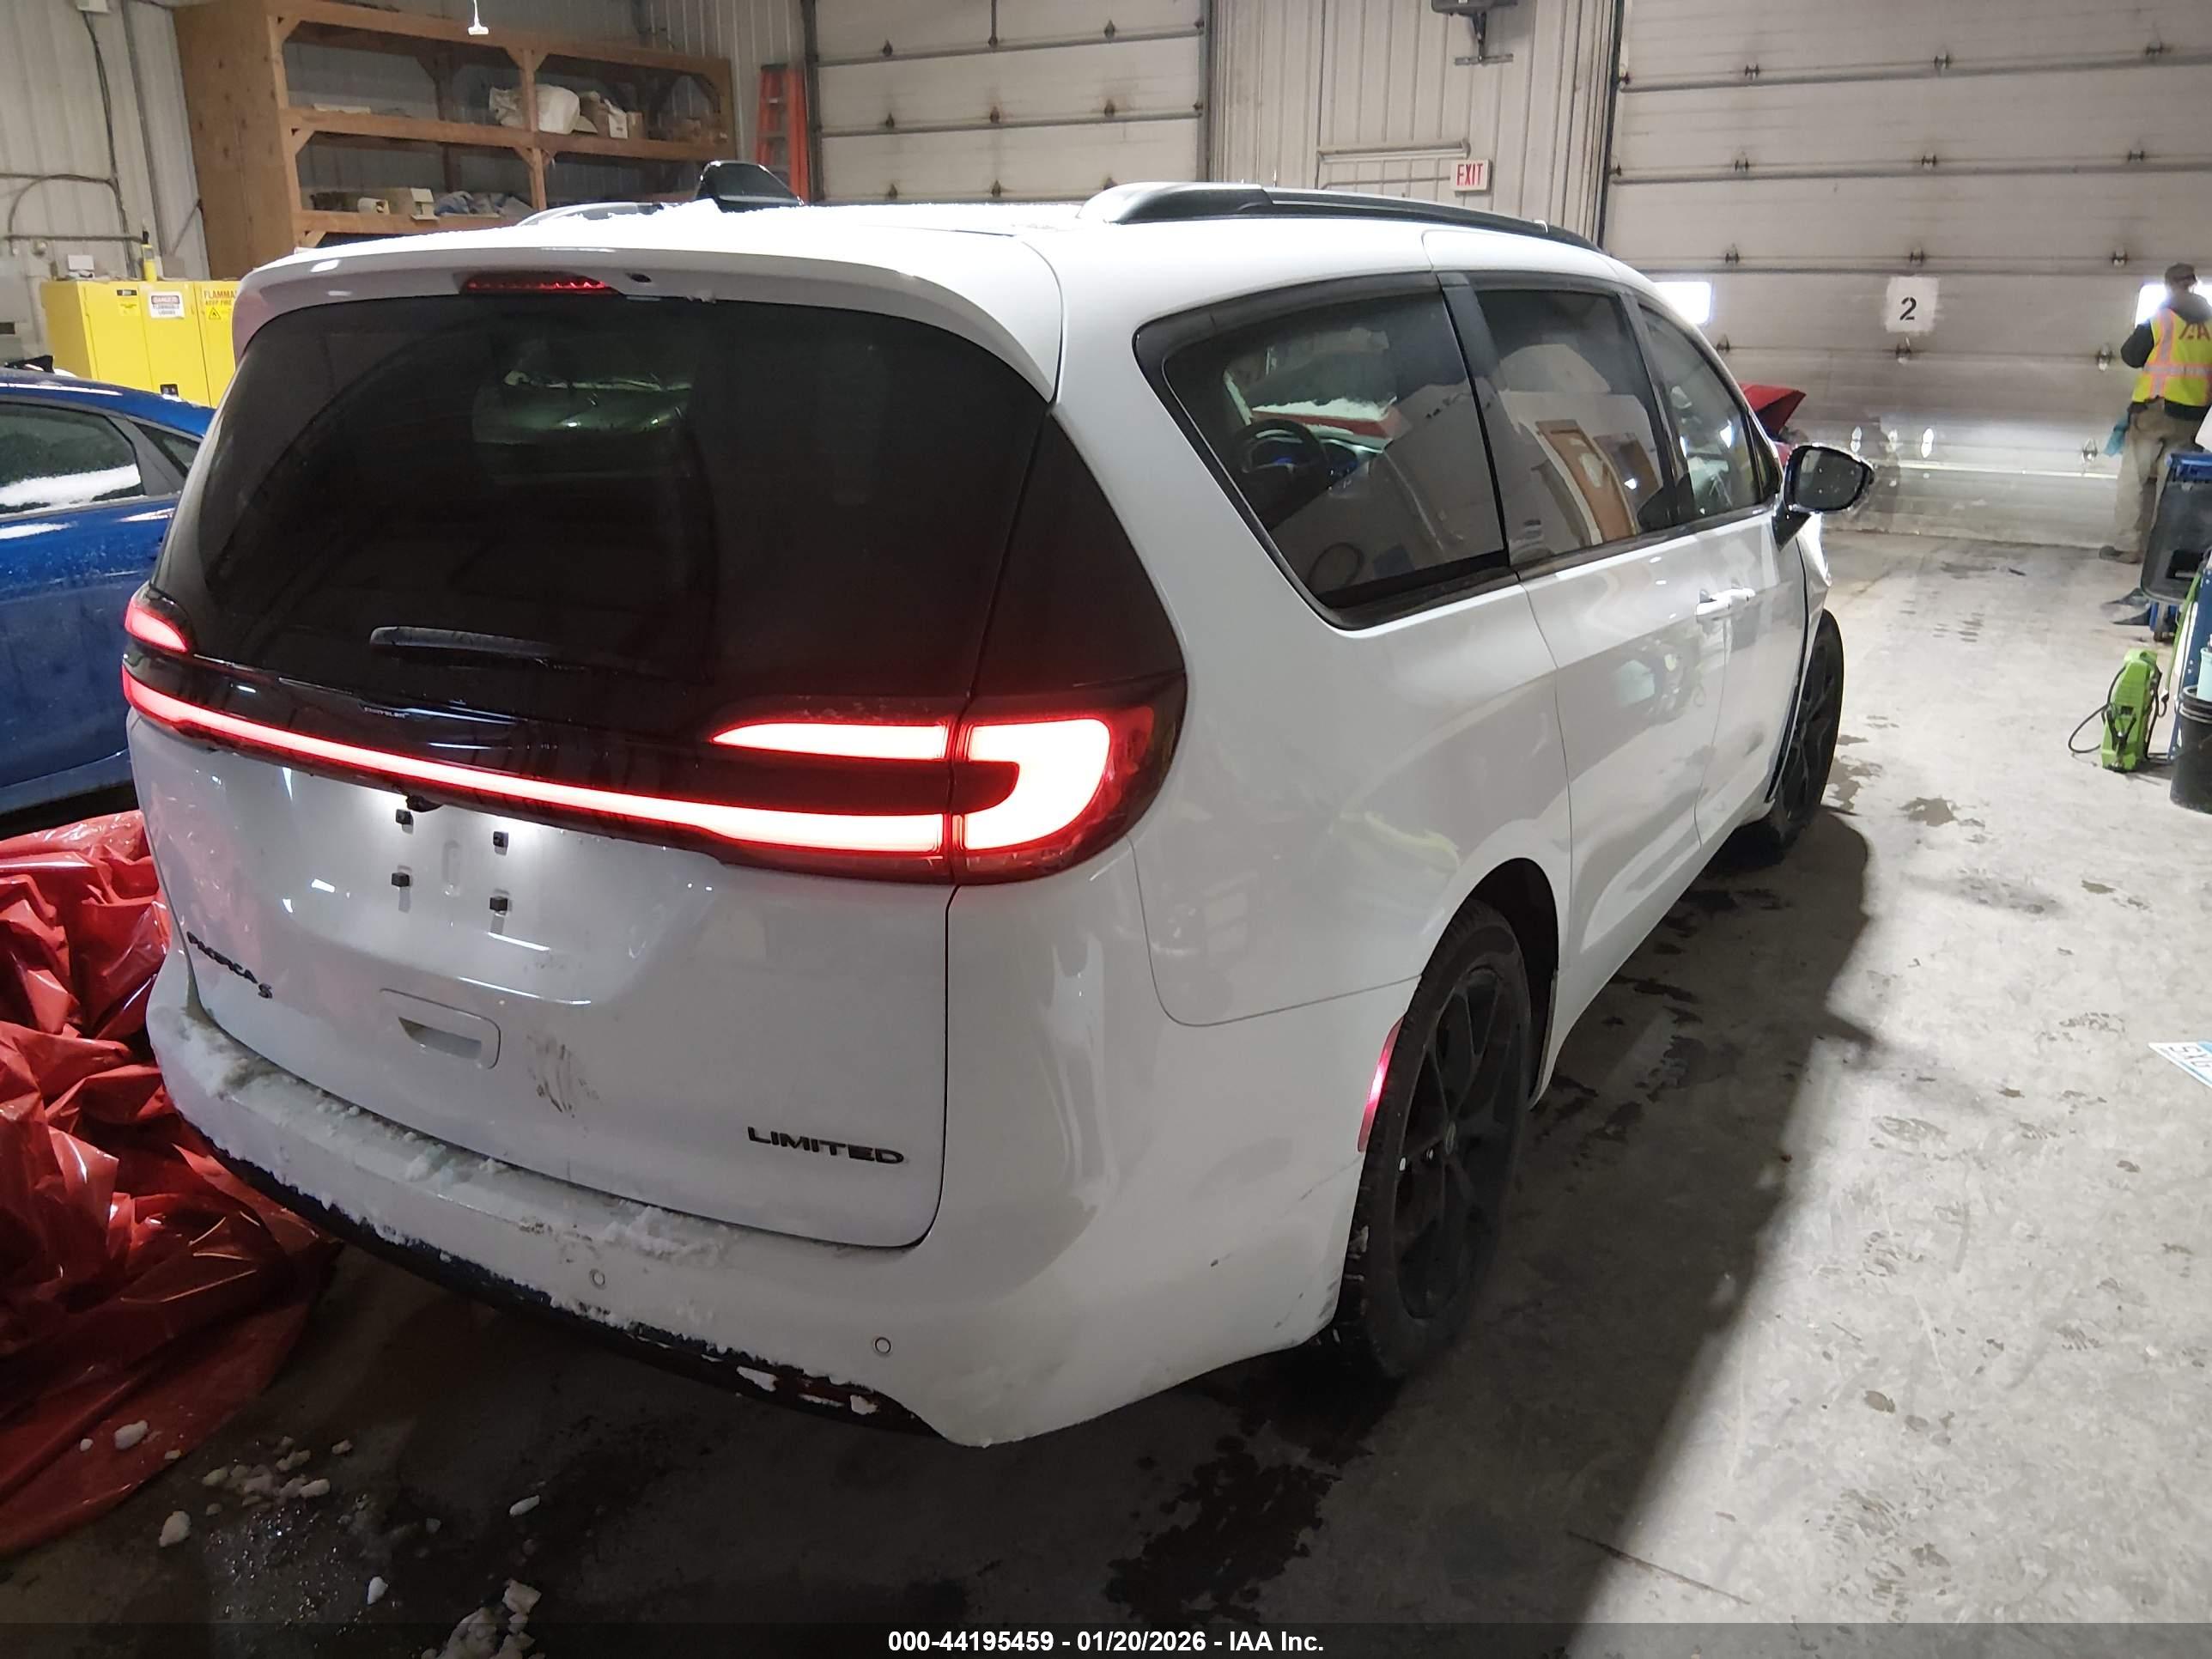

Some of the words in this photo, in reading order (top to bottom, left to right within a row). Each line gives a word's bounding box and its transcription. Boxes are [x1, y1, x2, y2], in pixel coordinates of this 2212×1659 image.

[1457, 163, 1483, 186] EXIT
[204, 289, 236, 299] FLAMMA
[1899, 297, 1917, 320] 2
[258, 982, 273, 999] S
[747, 1126, 904, 1164] LIMITED
